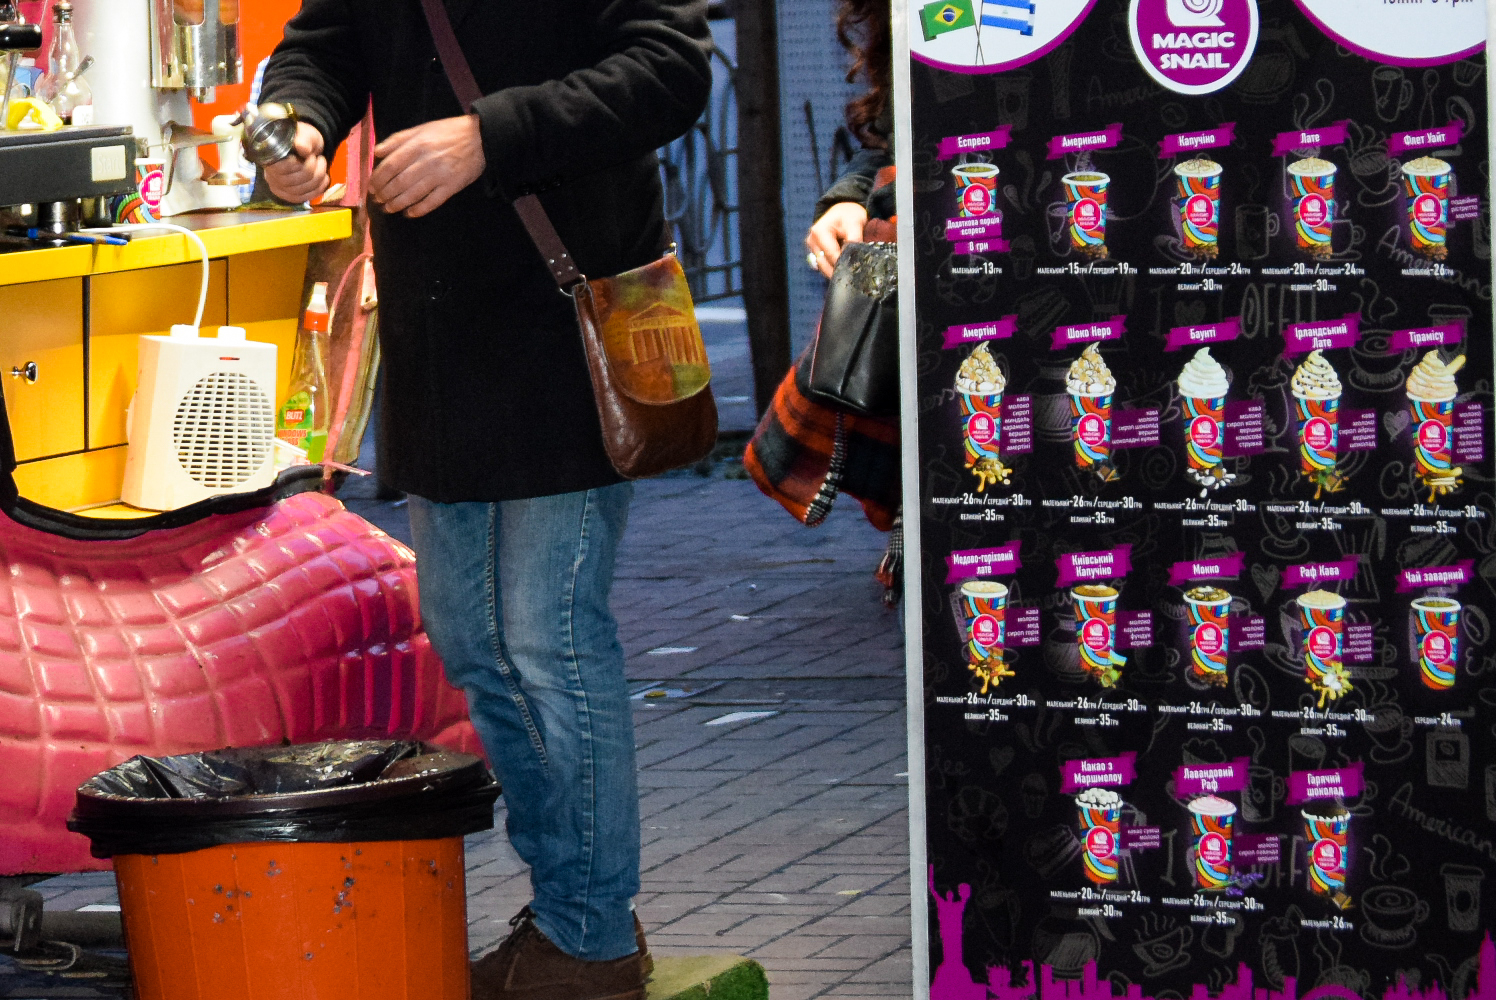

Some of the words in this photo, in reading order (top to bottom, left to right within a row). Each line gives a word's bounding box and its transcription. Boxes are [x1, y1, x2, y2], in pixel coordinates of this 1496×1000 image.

[1152, 31, 1236, 49] MAGIC
[1160, 52, 1231, 69] SNAIL
[958, 137, 990, 148] Еспресо
[1062, 135, 1106, 148] Американо
[1179, 134, 1215, 147] Капучіно
[1301, 133, 1320, 143] Лате
[1404, 135, 1424, 145] Флет
[1427, 132, 1445, 143] Уайт
[964, 325, 996, 339] Амертіні
[1068, 328, 1089, 339] Шоко
[1092, 326, 1111, 338] Неро
[1190, 329, 1215, 340] Баунті
[1409, 332, 1443, 344] Тірамісу
[1072, 553, 1113, 565] Київський
[1076, 566, 1111, 578] Капучіно
[1082, 761, 1105, 771] Какао
